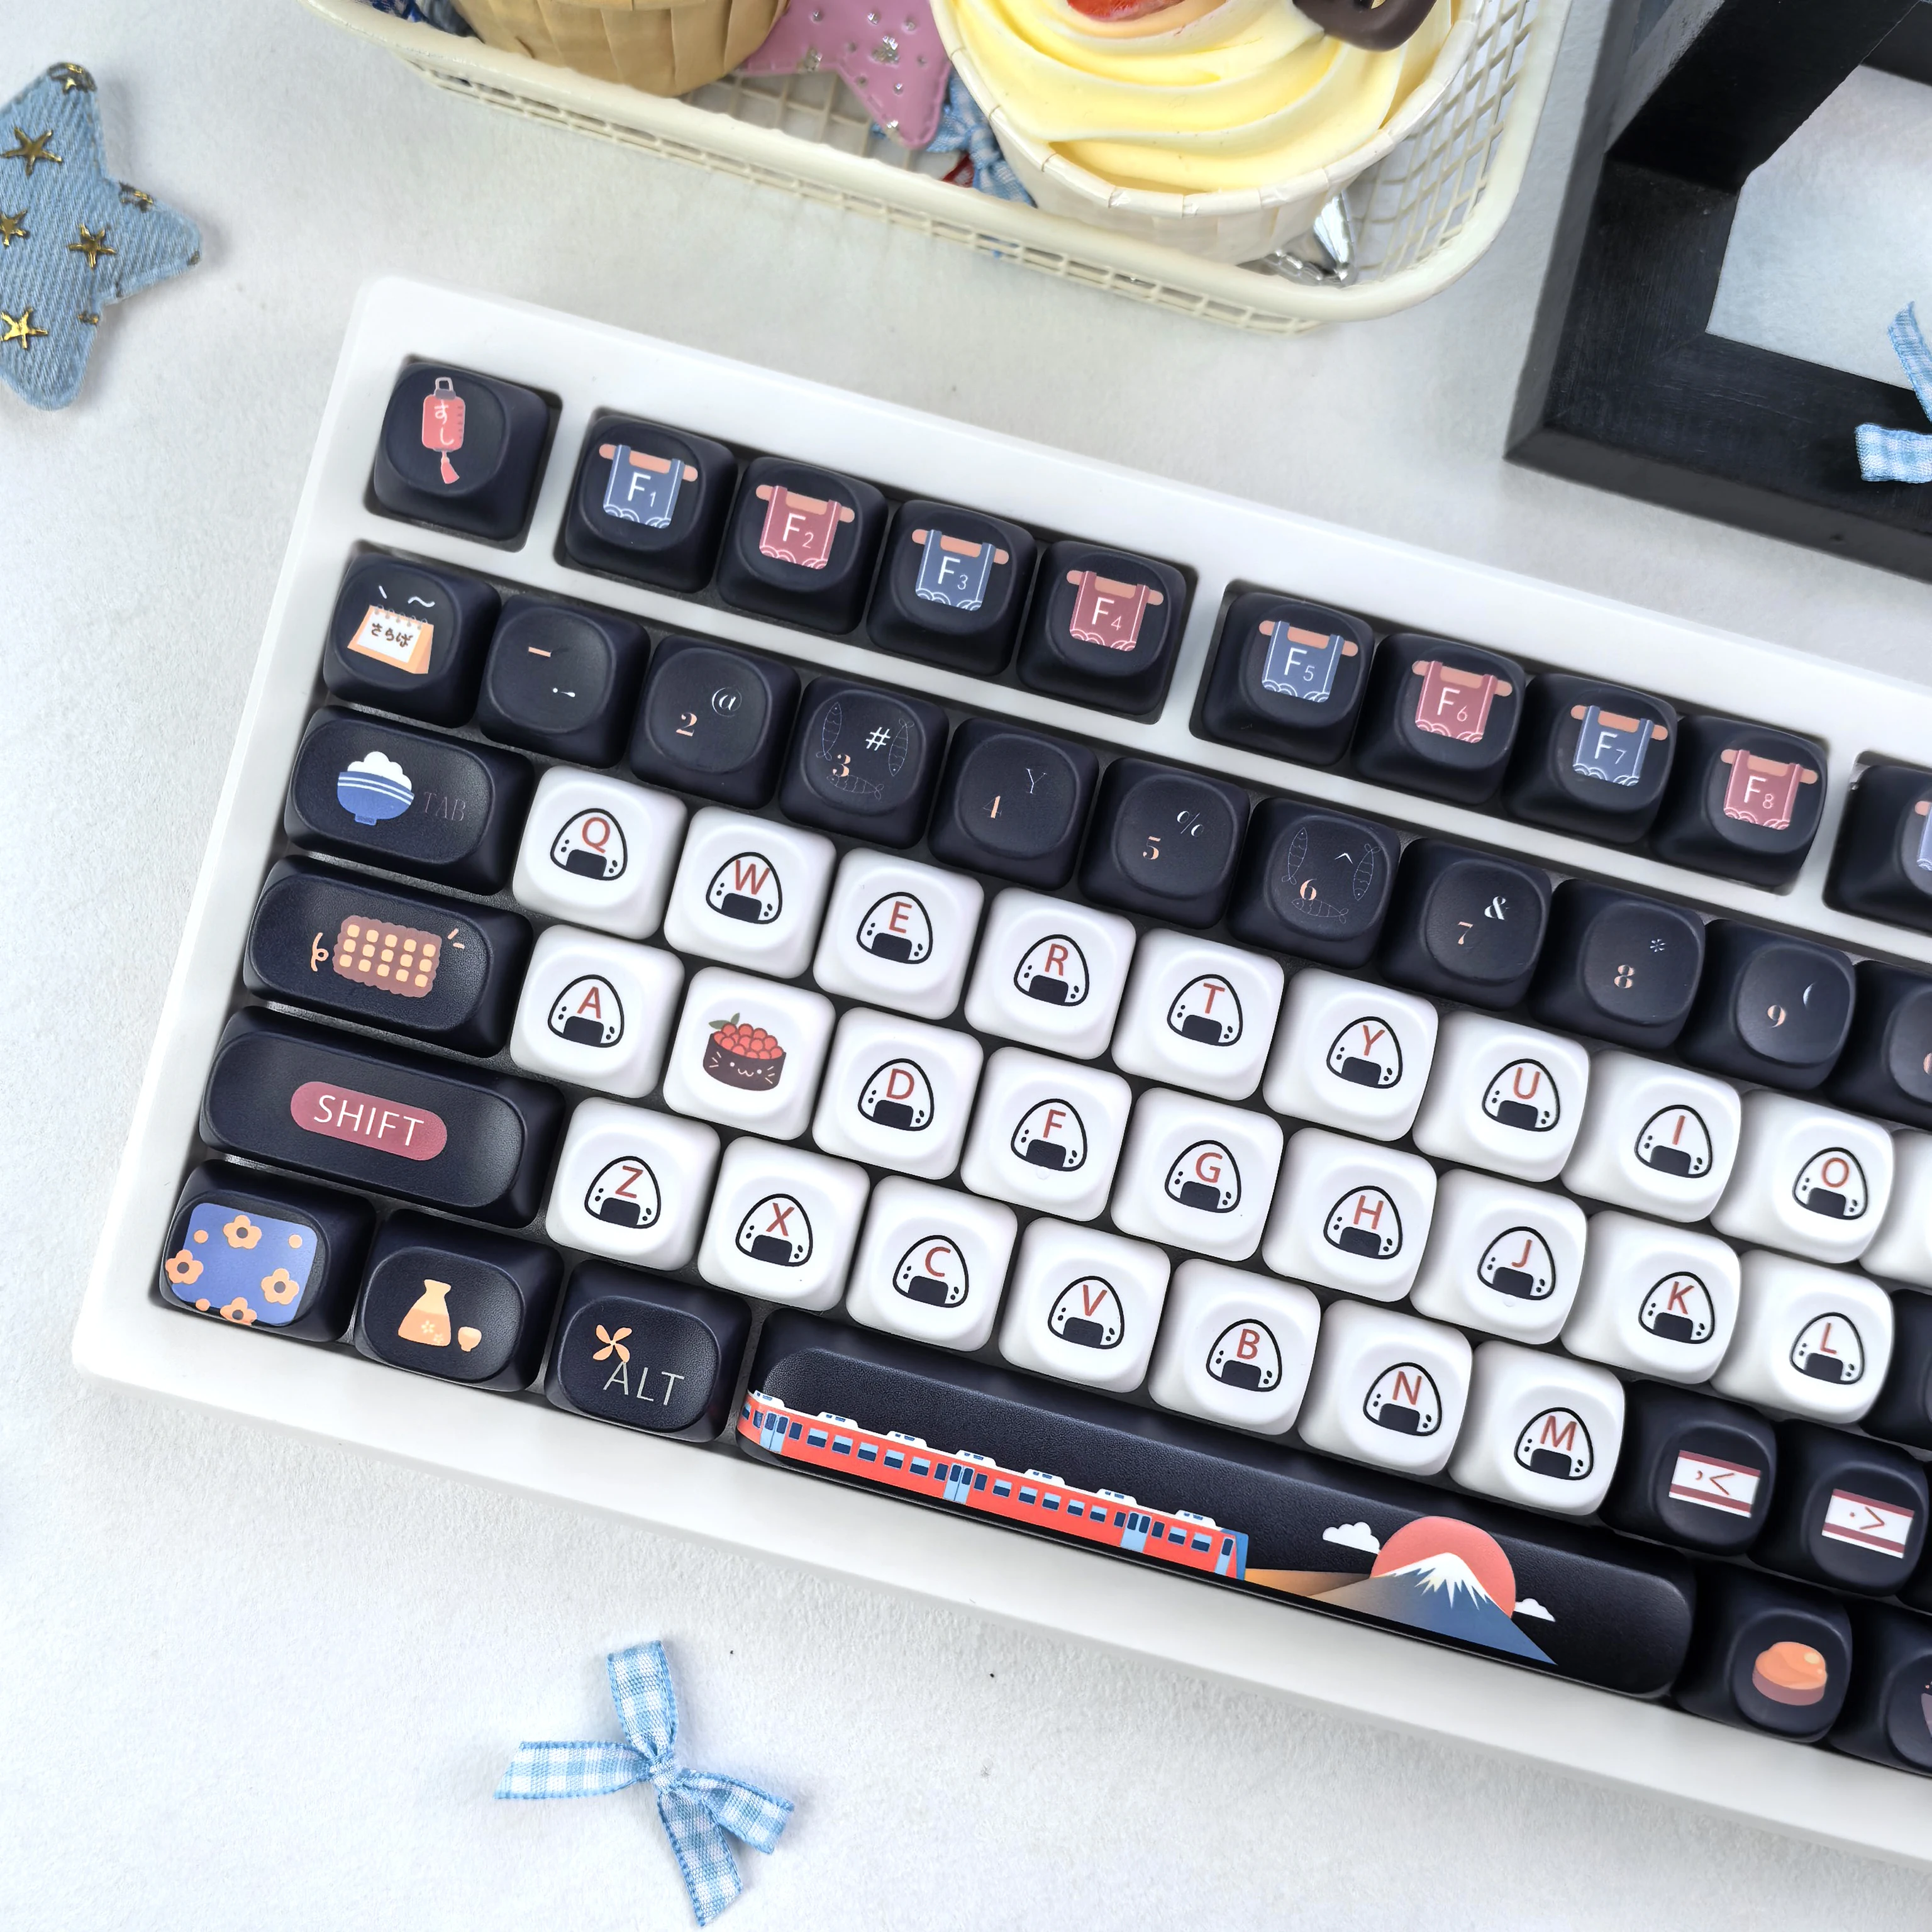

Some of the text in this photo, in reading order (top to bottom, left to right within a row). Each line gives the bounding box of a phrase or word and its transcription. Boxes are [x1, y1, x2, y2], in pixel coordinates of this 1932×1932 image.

[434, 398, 454, 445] すし
[626, 472, 656, 511] F1
[779, 513, 814, 552] F2
[938, 556, 969, 590] F3
[1092, 597, 1121, 630] F4
[371, 623, 413, 648] さらば
[1281, 647, 1314, 685] F5
[711, 687, 742, 714] @
[1437, 687, 1467, 722] F6
[675, 712, 697, 737] 2
[865, 726, 894, 755] #
[1594, 731, 1625, 764] F7
[830, 754, 851, 778] 3
[423, 791, 467, 821] TAB
[1743, 775, 1774, 809] F8
[581, 817, 610, 853] Q
[1177, 810, 1203, 836] %
[1142, 836, 1161, 860] 5
[735, 860, 769, 896] W
[1295, 878, 1317, 904] 6
[888, 902, 911, 934] E
[1484, 896, 1509, 921] &
[1457, 921, 1474, 945] 7
[1044, 944, 1068, 976] R
[1614, 964, 1636, 989] 8
[577, 987, 601, 1019] A
[1204, 984, 1224, 1014] T
[1764, 1004, 1788, 1032] 9
[1362, 1026, 1384, 1057] Y
[886, 1069, 914, 1100] D
[1513, 1068, 1540, 1100] U
[313, 1094, 425, 1146] SHIFT
[1043, 1109, 1065, 1138] F
[1673, 1116, 1684, 1145] I
[614, 1166, 642, 1199] Z
[1195, 1152, 1222, 1184] G
[1821, 1158, 1850, 1188] O
[766, 1204, 793, 1237] X
[1353, 1196, 1383, 1230] H
[924, 1247, 950, 1277] C
[1512, 1241, 1531, 1268] J
[1082, 1284, 1107, 1317] V
[1668, 1284, 1692, 1314] K
[1236, 1329, 1260, 1360] B
[1820, 1326, 1836, 1355] L
[602, 1362, 685, 1406] ALT
[1392, 1372, 1421, 1406] N
[1540, 1416, 1577, 1452] M
